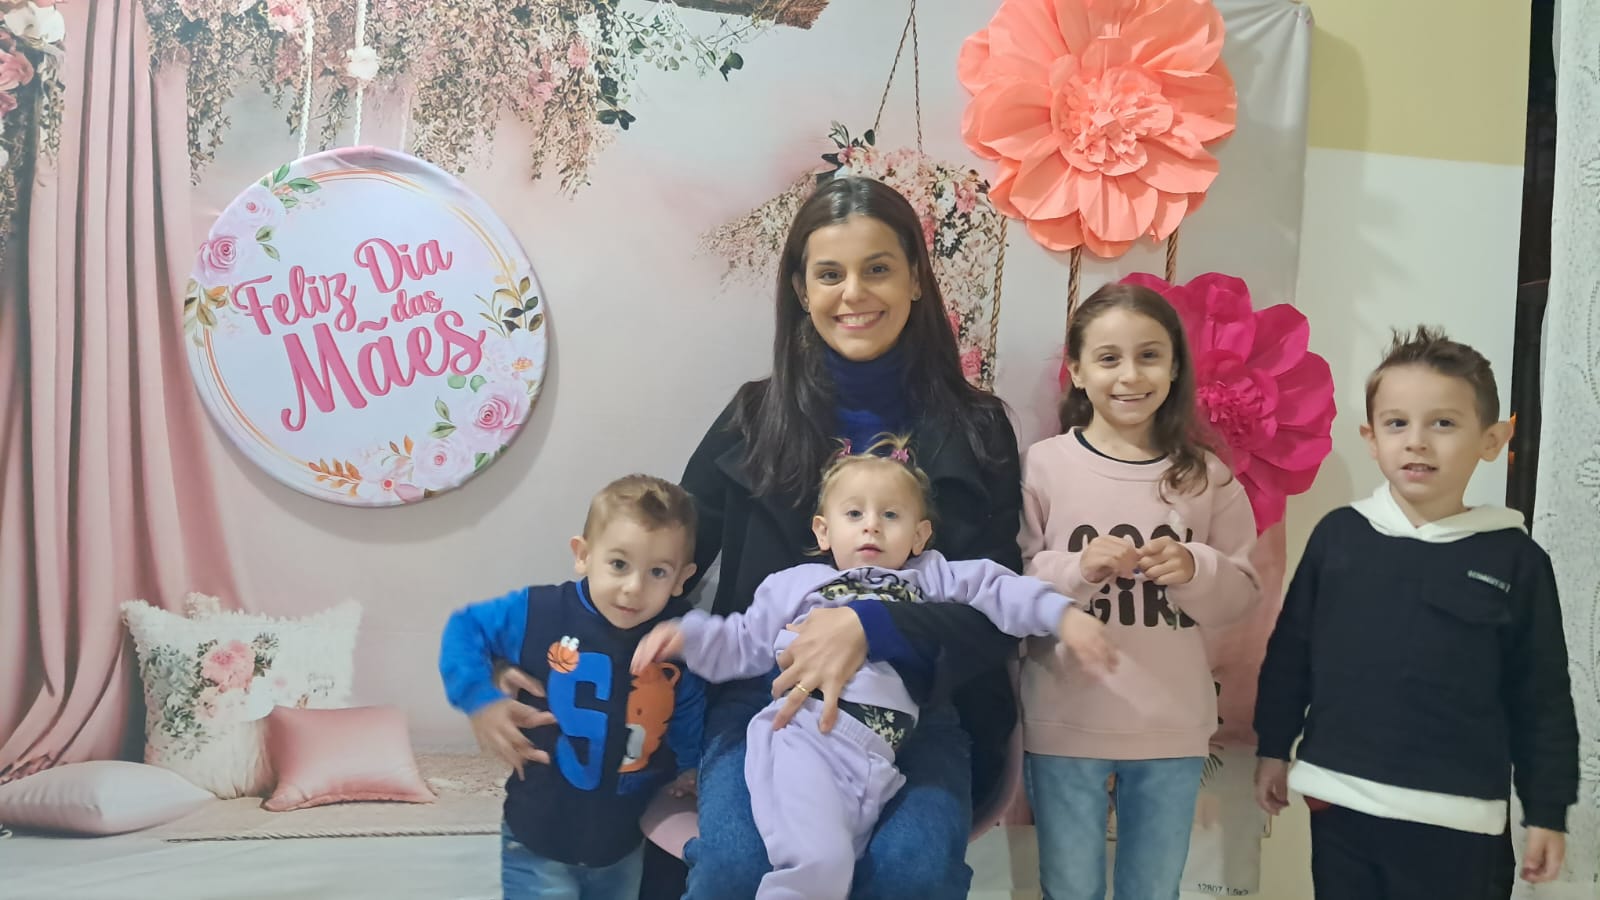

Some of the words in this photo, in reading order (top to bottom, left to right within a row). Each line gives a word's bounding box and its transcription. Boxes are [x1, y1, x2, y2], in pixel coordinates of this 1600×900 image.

[231, 265, 357, 335] Feliz
[353, 237, 453, 293] Dia
[390, 289, 443, 323] das
[280, 310, 487, 432] Mães
